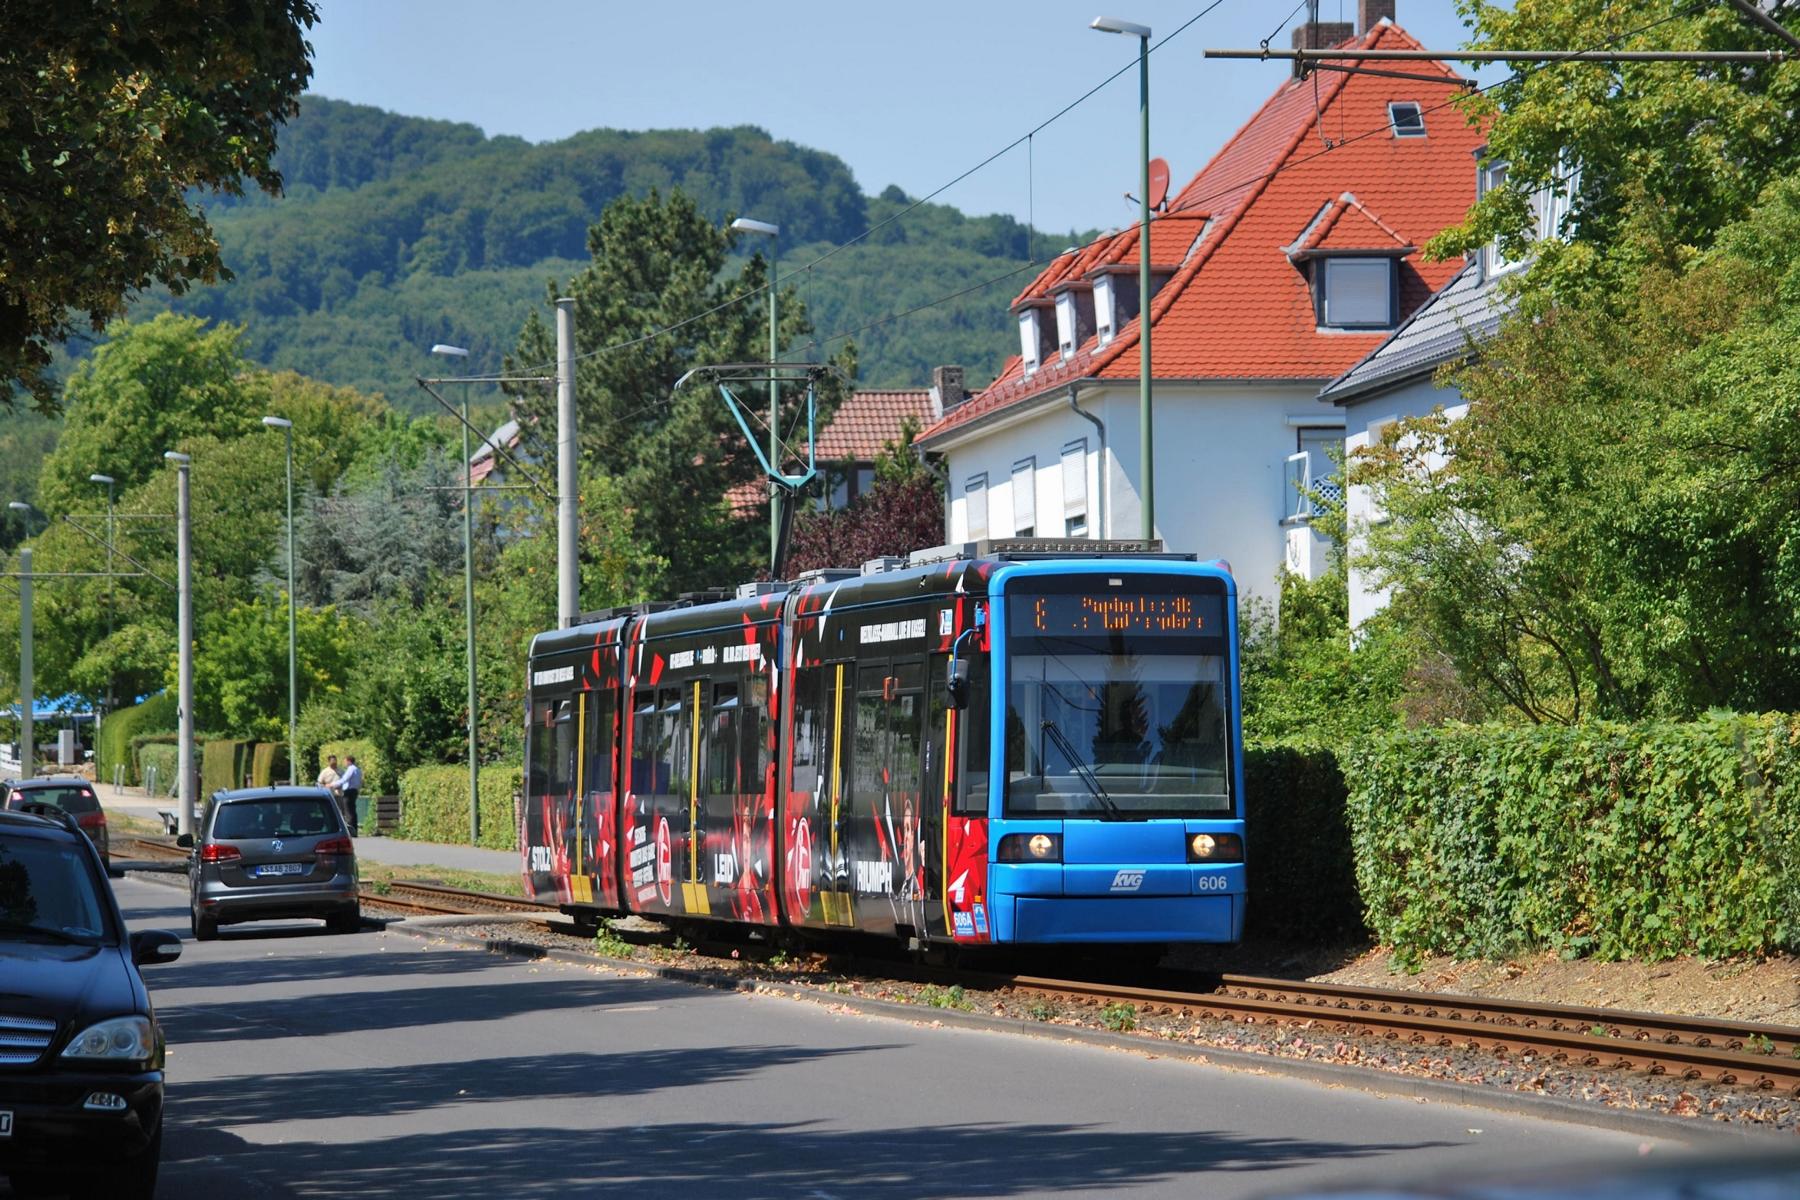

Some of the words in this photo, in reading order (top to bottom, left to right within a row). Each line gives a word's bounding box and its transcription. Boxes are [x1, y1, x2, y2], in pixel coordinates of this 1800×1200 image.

[532, 846, 551, 872] STOLZ
[714, 853, 734, 883] LEID
[1111, 873, 1144, 888] KVG
[1199, 876, 1227, 890] 606
[953, 911, 973, 928] 606A
